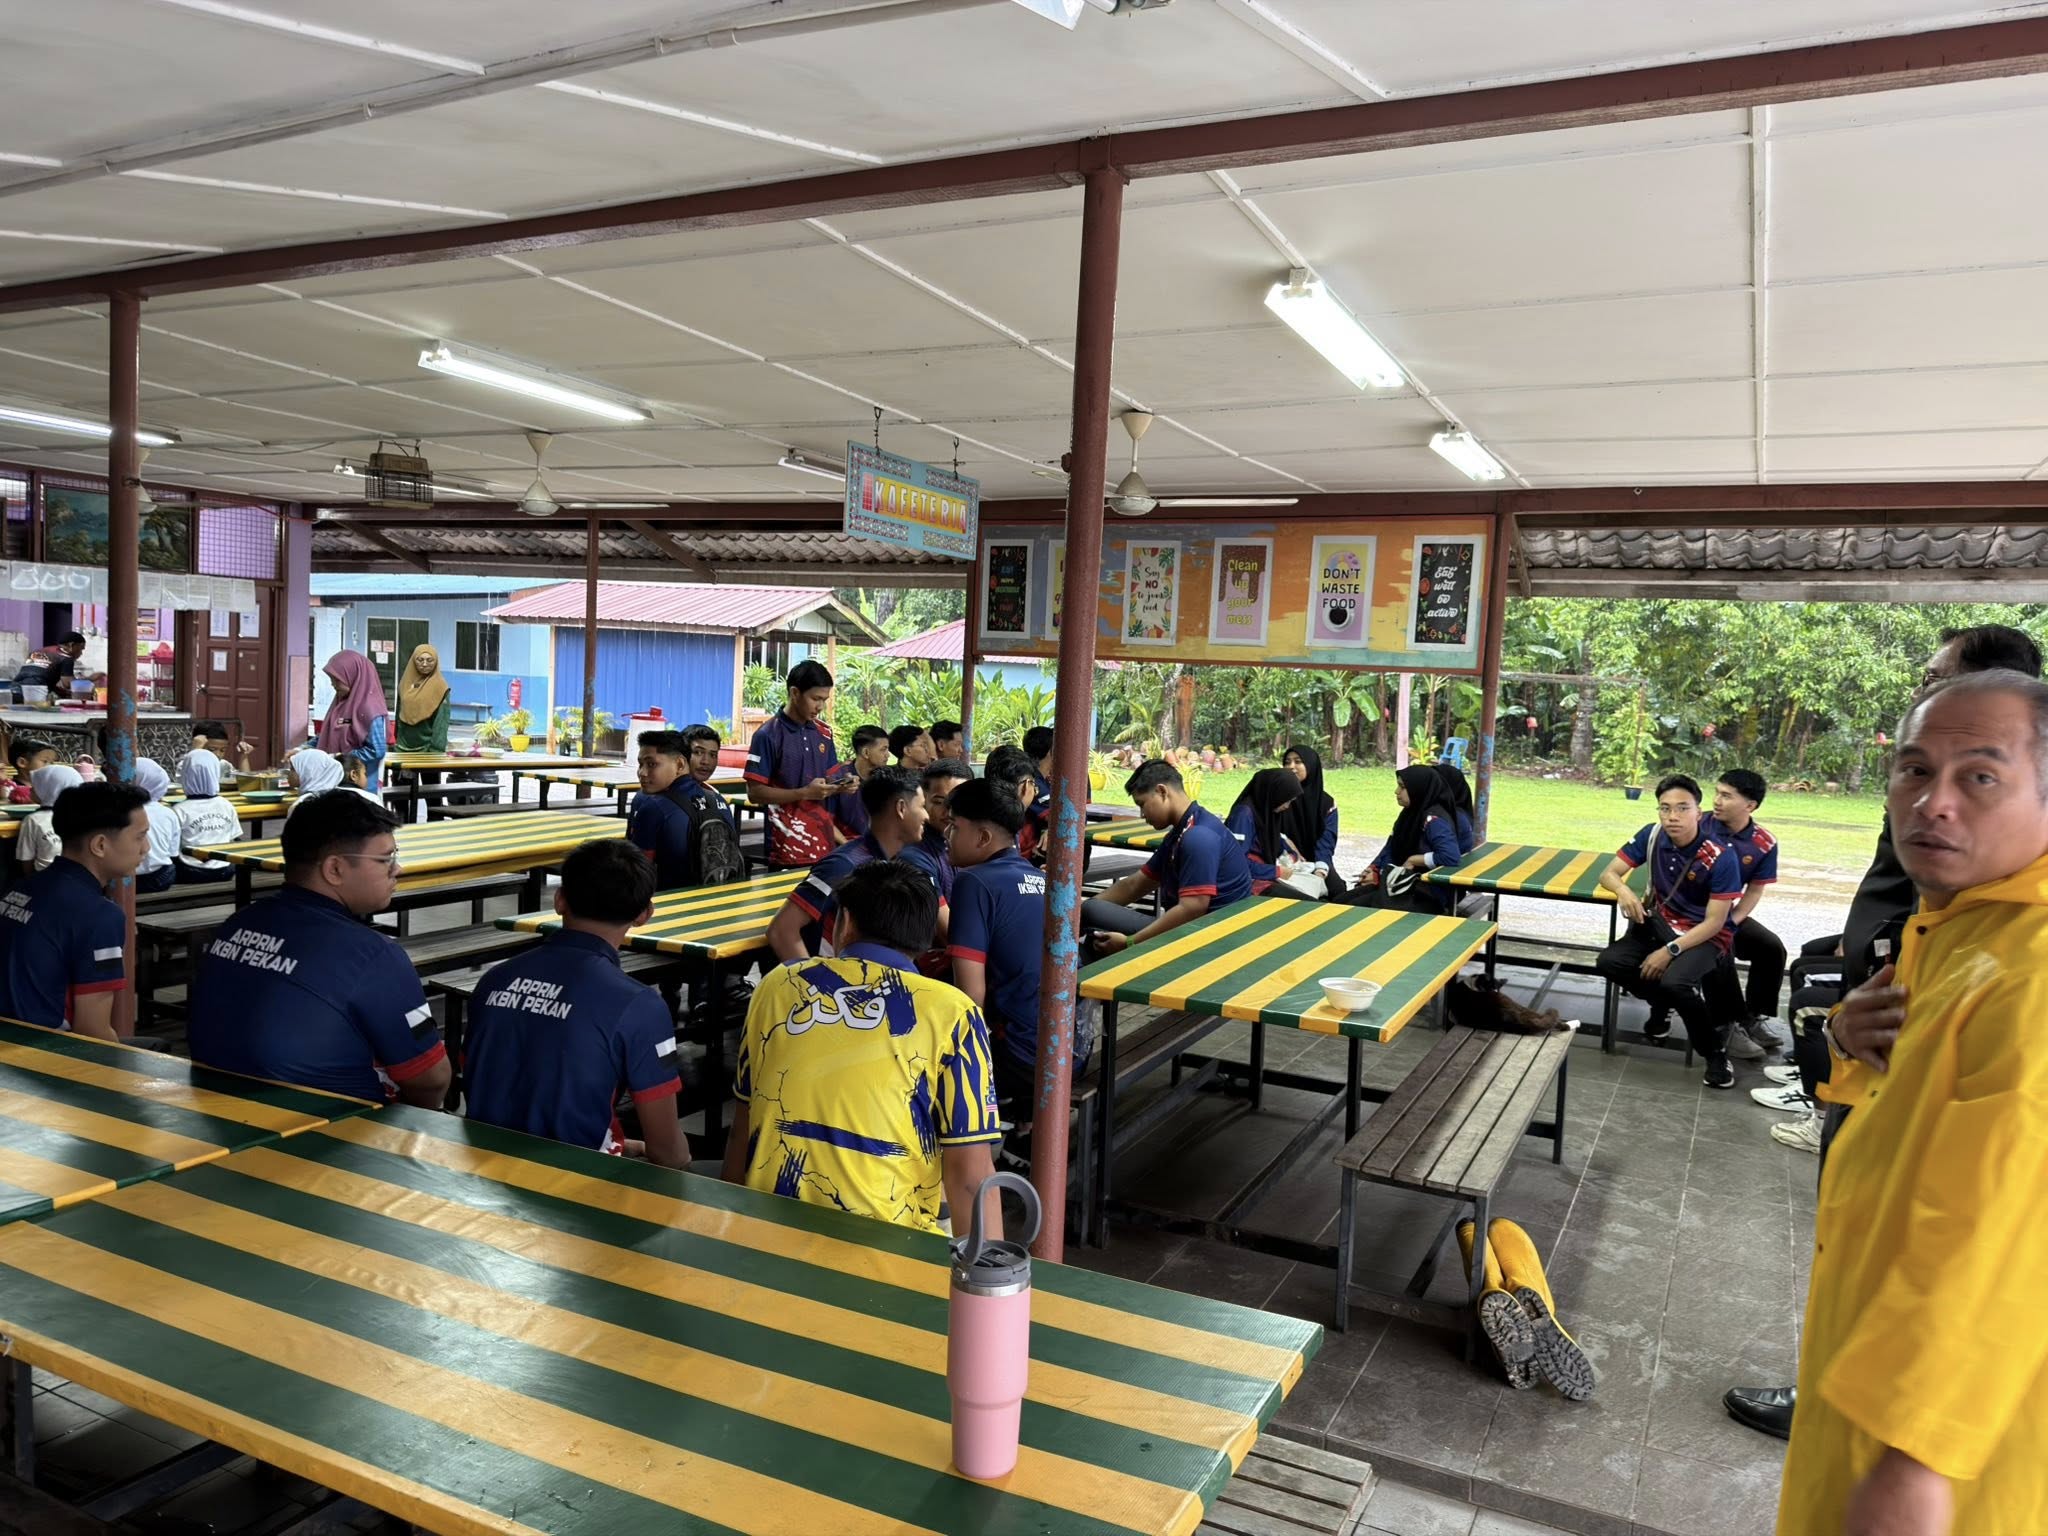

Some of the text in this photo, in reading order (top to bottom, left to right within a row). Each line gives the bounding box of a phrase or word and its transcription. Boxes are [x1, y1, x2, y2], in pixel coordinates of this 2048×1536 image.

[875, 480, 967, 534] KAFETERIA
[1228, 560, 1258, 571] Clean
[1145, 567, 1160, 578] Say
[1323, 568, 1361, 579] DON'T
[1434, 566, 1458, 578] Eat
[1145, 581, 1158, 589] NO
[1234, 580, 1249, 592] up
[1322, 583, 1360, 594] WASTE
[1433, 580, 1456, 591] well
[1227, 598, 1255, 611] your
[1322, 598, 1357, 609] FOOD
[1226, 614, 1252, 625] mess
[1017, 882, 1040, 895] IKBN
[229, 928, 285, 953] ARPRM
[210, 938, 298, 975] IKBN PEKAN
[506, 977, 563, 999] ARPRM
[485, 990, 572, 1019] IKBN PEKAN
